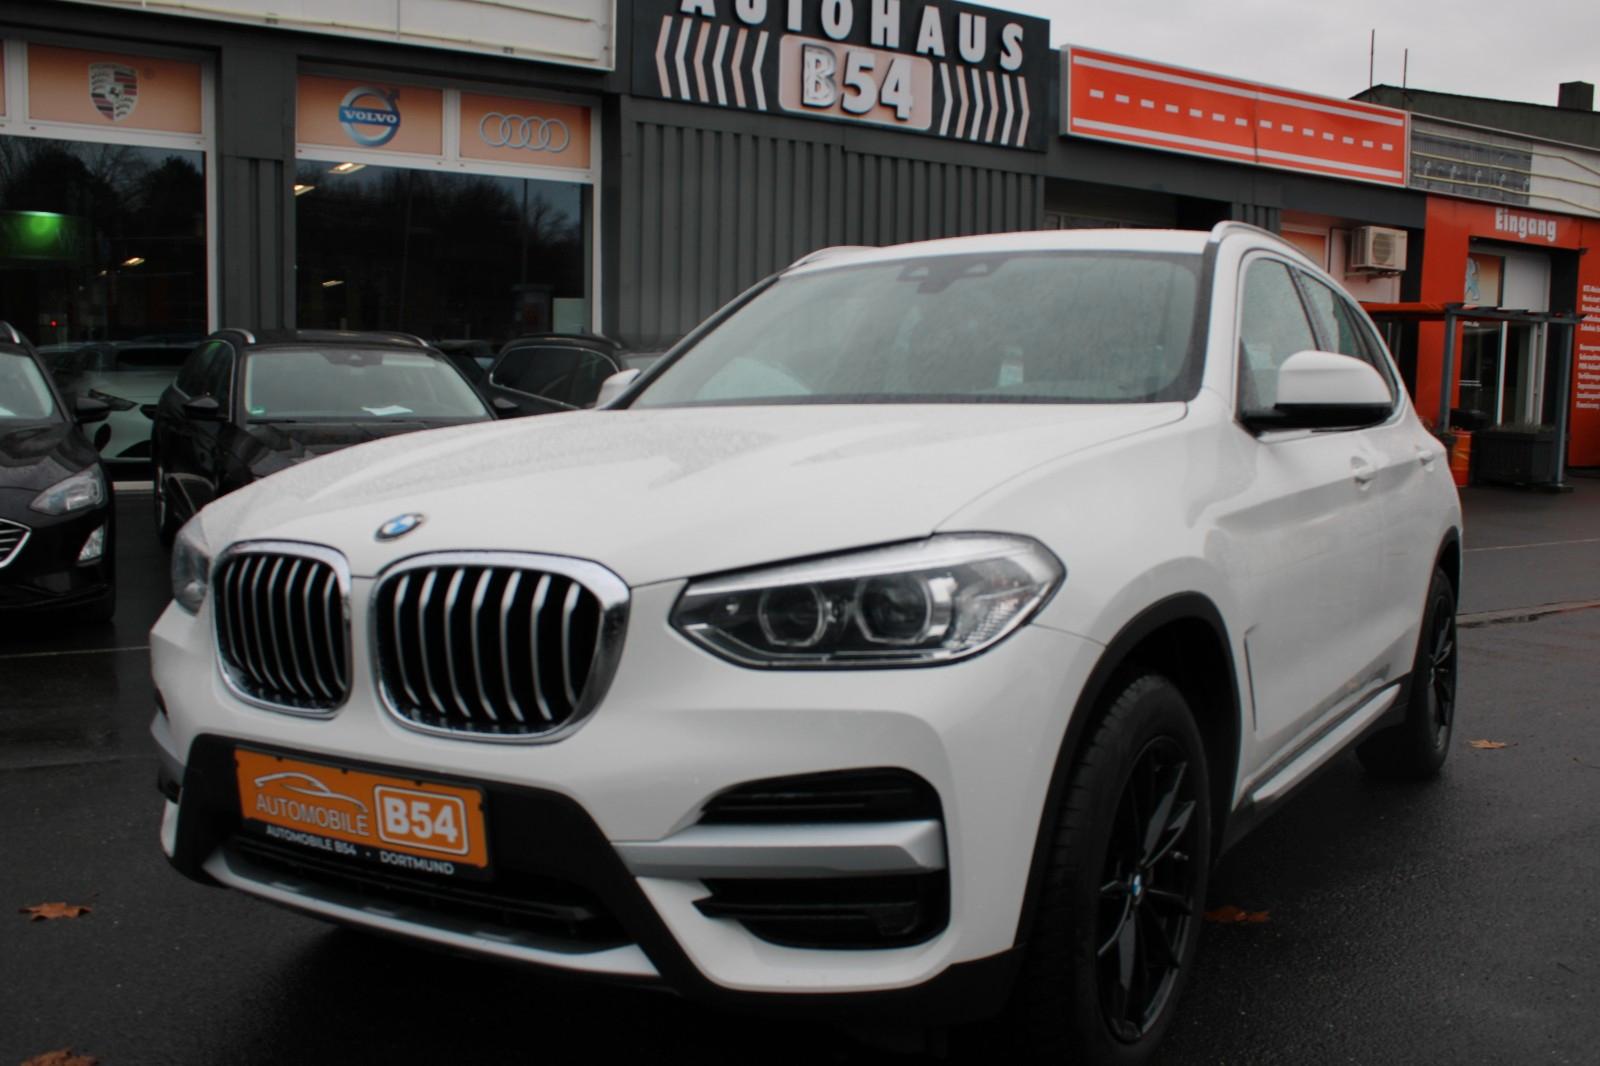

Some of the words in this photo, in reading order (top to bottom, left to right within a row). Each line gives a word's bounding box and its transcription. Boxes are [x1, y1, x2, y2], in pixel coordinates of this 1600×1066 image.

[802, 44, 914, 120] B54
[344, 110, 397, 124] VOLVO
[1495, 207, 1557, 242] Eingang
[256, 793, 370, 837] AUTOMOBILE
[384, 797, 458, 843] B54
[266, 824, 333, 851] AUTOMOBILE
[335, 840, 357, 855] B54
[380, 850, 454, 875] DORTMUND
